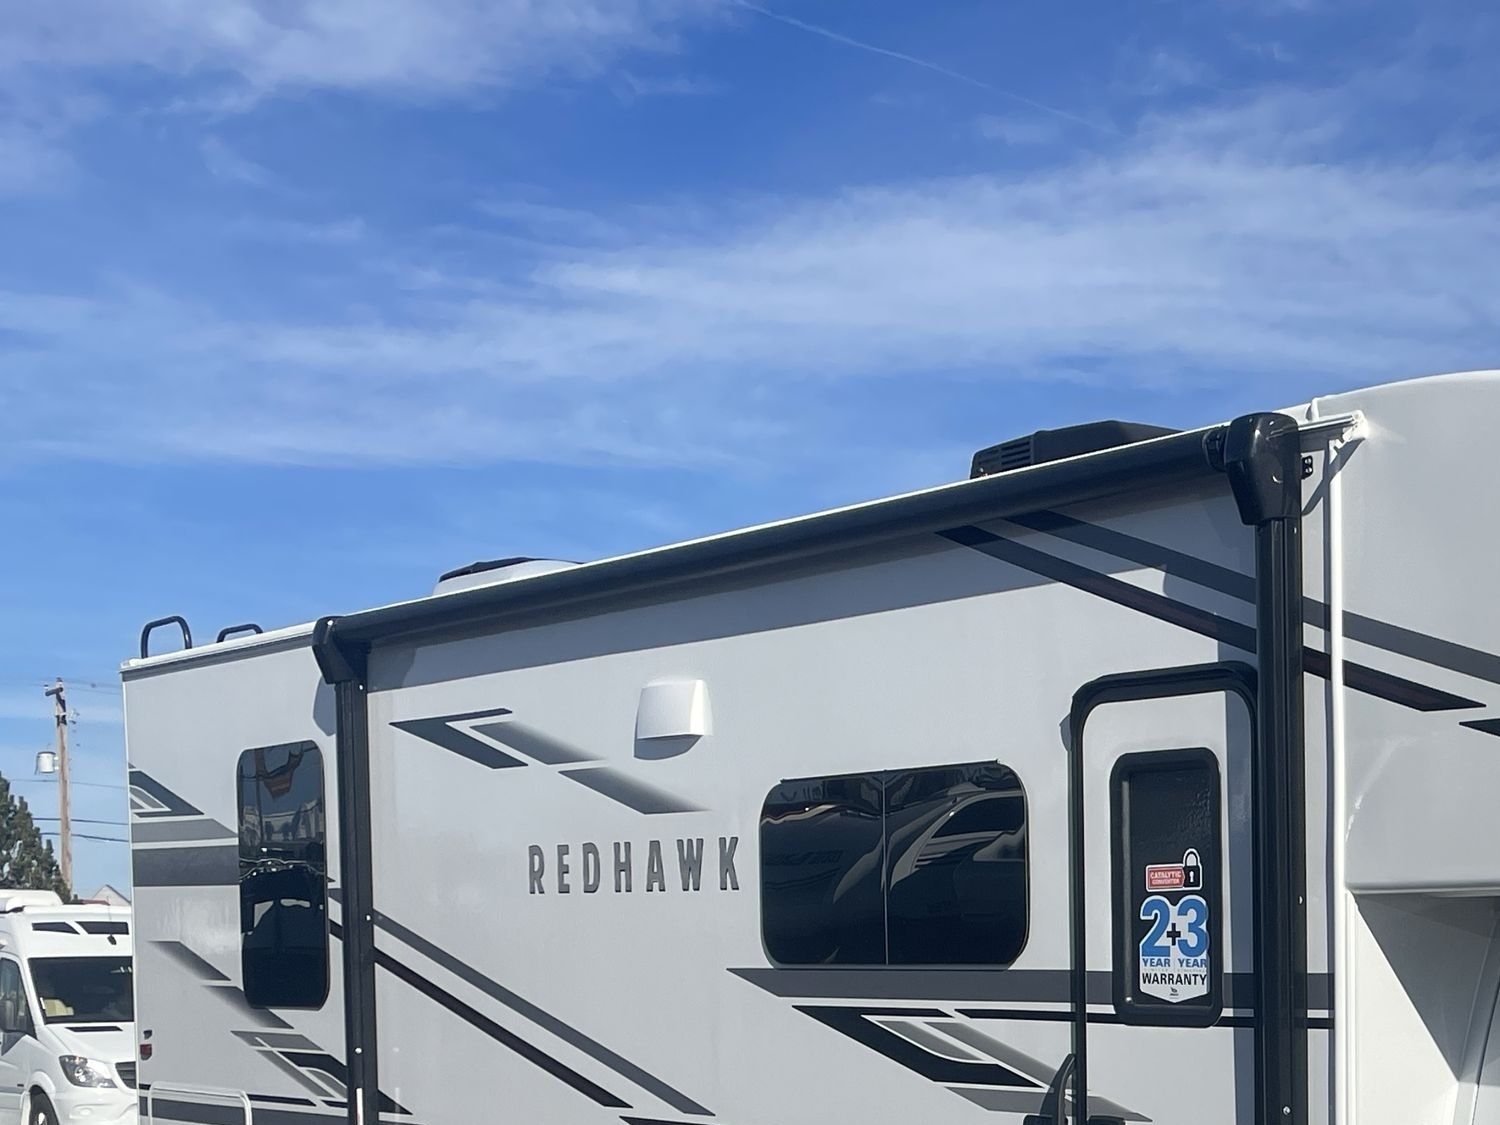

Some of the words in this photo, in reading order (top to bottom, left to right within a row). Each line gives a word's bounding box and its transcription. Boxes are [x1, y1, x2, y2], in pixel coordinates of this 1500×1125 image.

[528, 837, 740, 895] REDHAWK
[1150, 870, 1182, 879] CATALYTIC
[1142, 958, 1171, 968] YEAR
[1178, 958, 1208, 968] YEAR
[1142, 973, 1208, 986] WARRANTY
